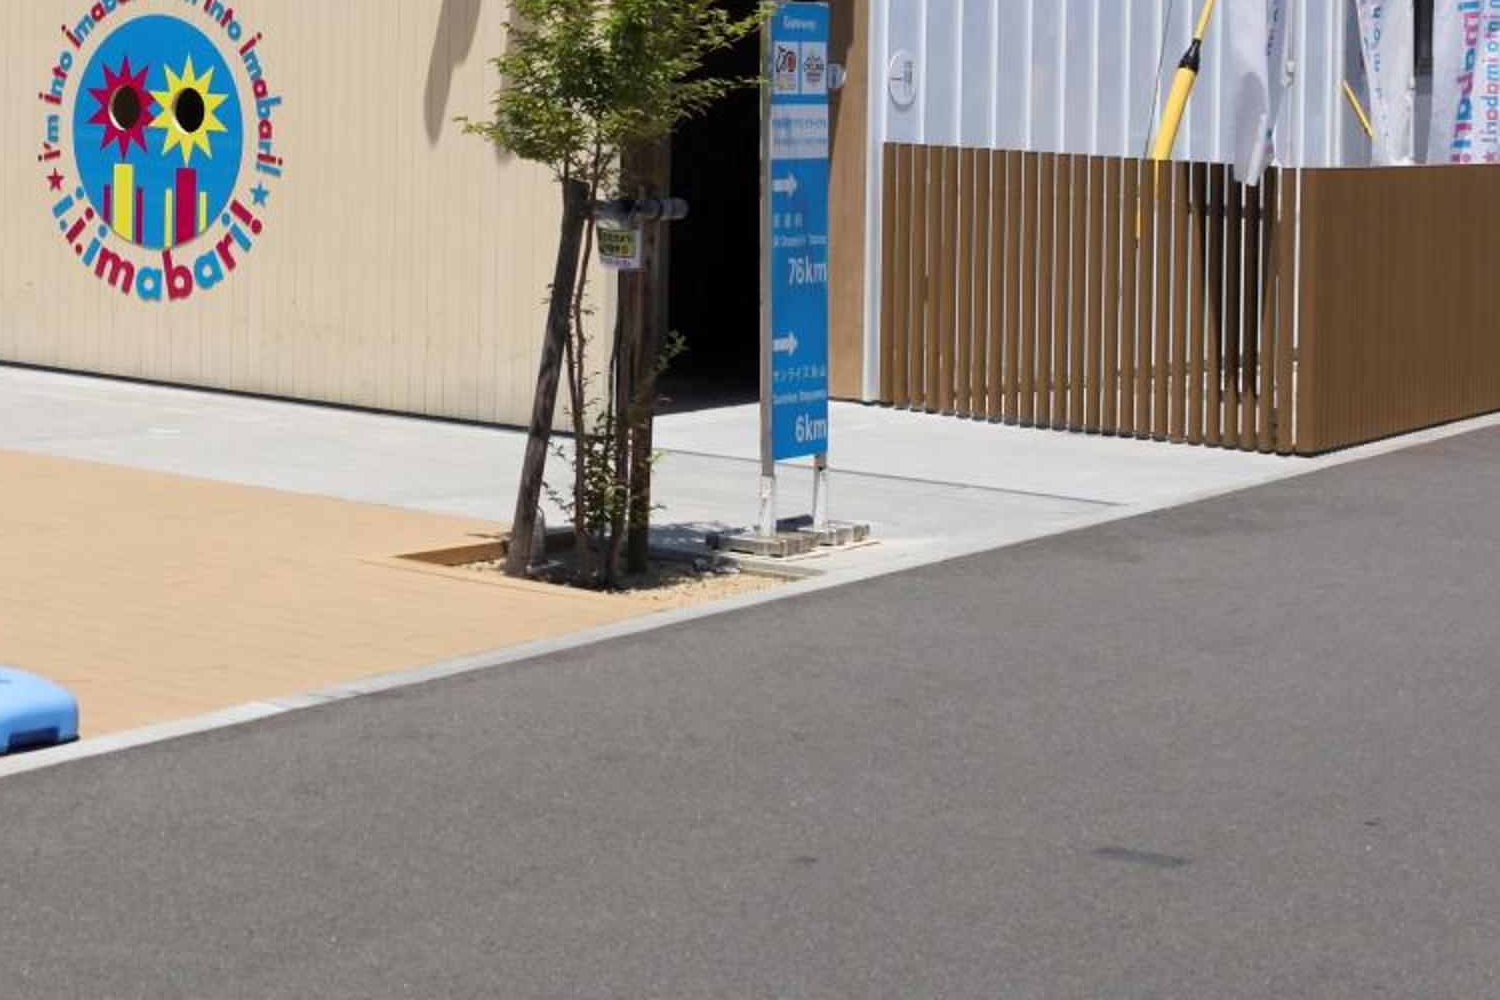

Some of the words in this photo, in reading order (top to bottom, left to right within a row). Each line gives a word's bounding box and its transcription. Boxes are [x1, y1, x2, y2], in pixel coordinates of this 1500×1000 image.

[38, 51, 73, 105] into
[52, 186, 263, 302] i.i.imabari!
[787, 255, 827, 284] 76km
[794, 412, 827, 443] 6km
